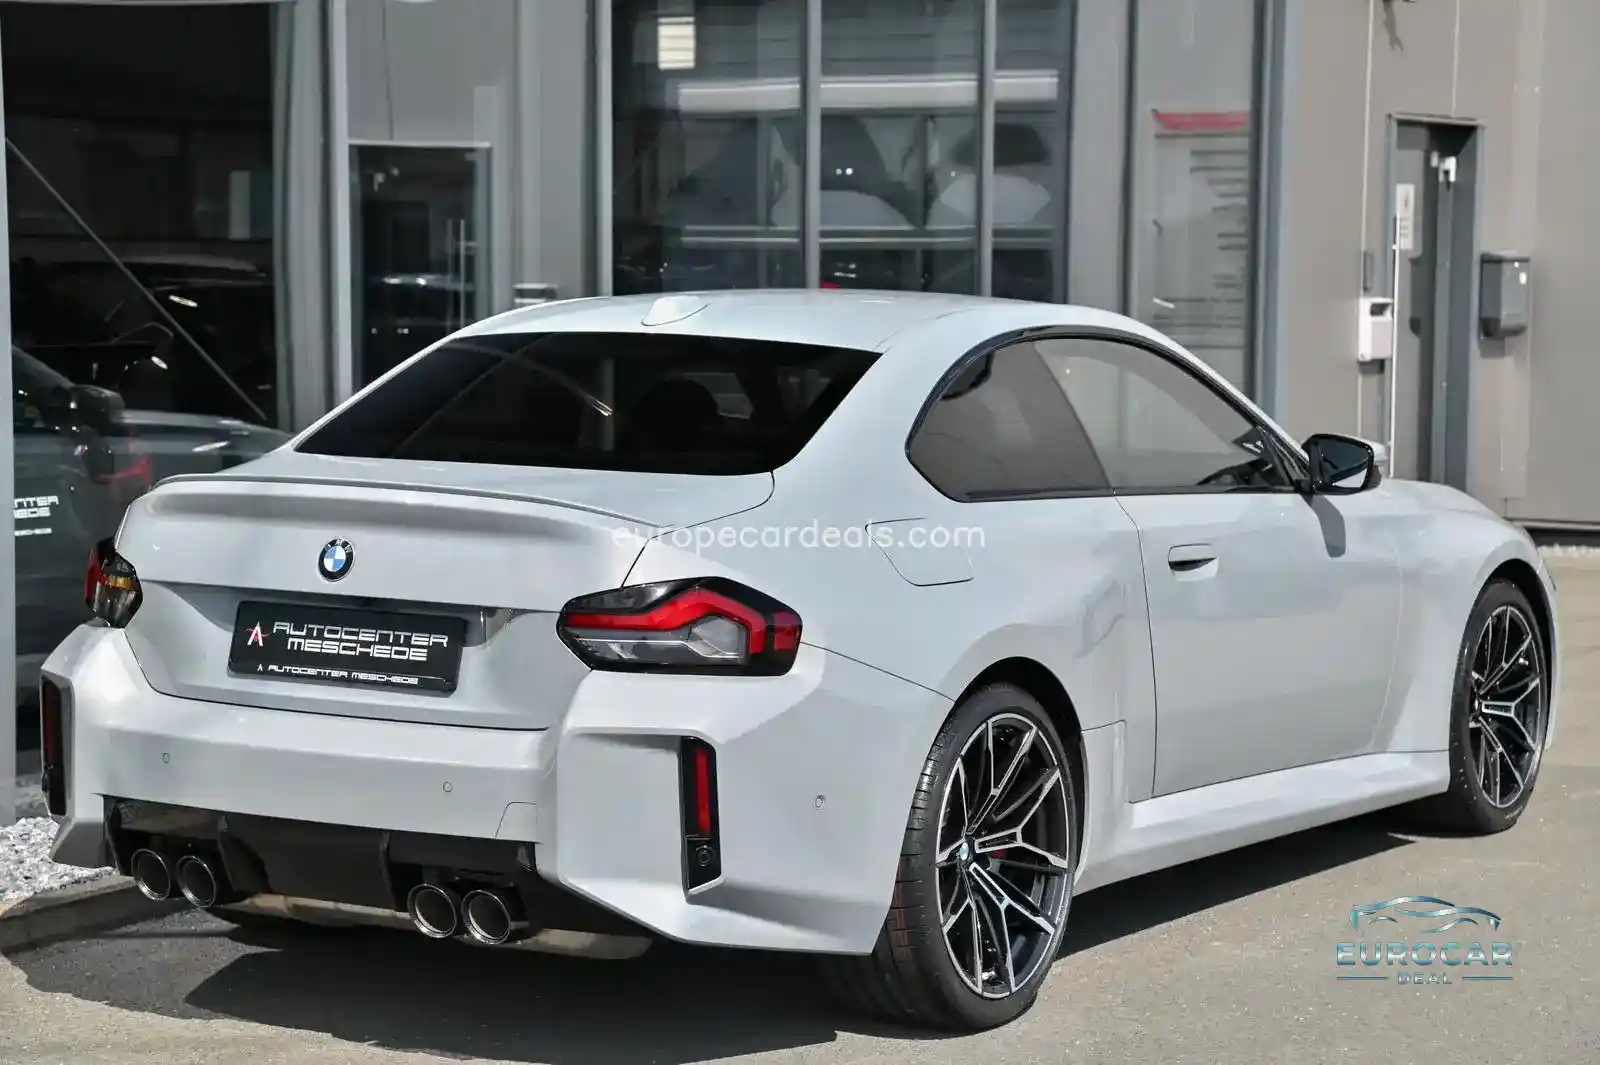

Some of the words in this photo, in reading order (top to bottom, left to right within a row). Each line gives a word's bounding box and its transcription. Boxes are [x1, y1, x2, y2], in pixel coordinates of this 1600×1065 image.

[273, 621, 448, 647] AUTOCENTER
[287, 638, 428, 661] MESCHEDE
[268, 664, 348, 678] AUTOCENTER
[351, 672, 418, 684] MESCHEDE
